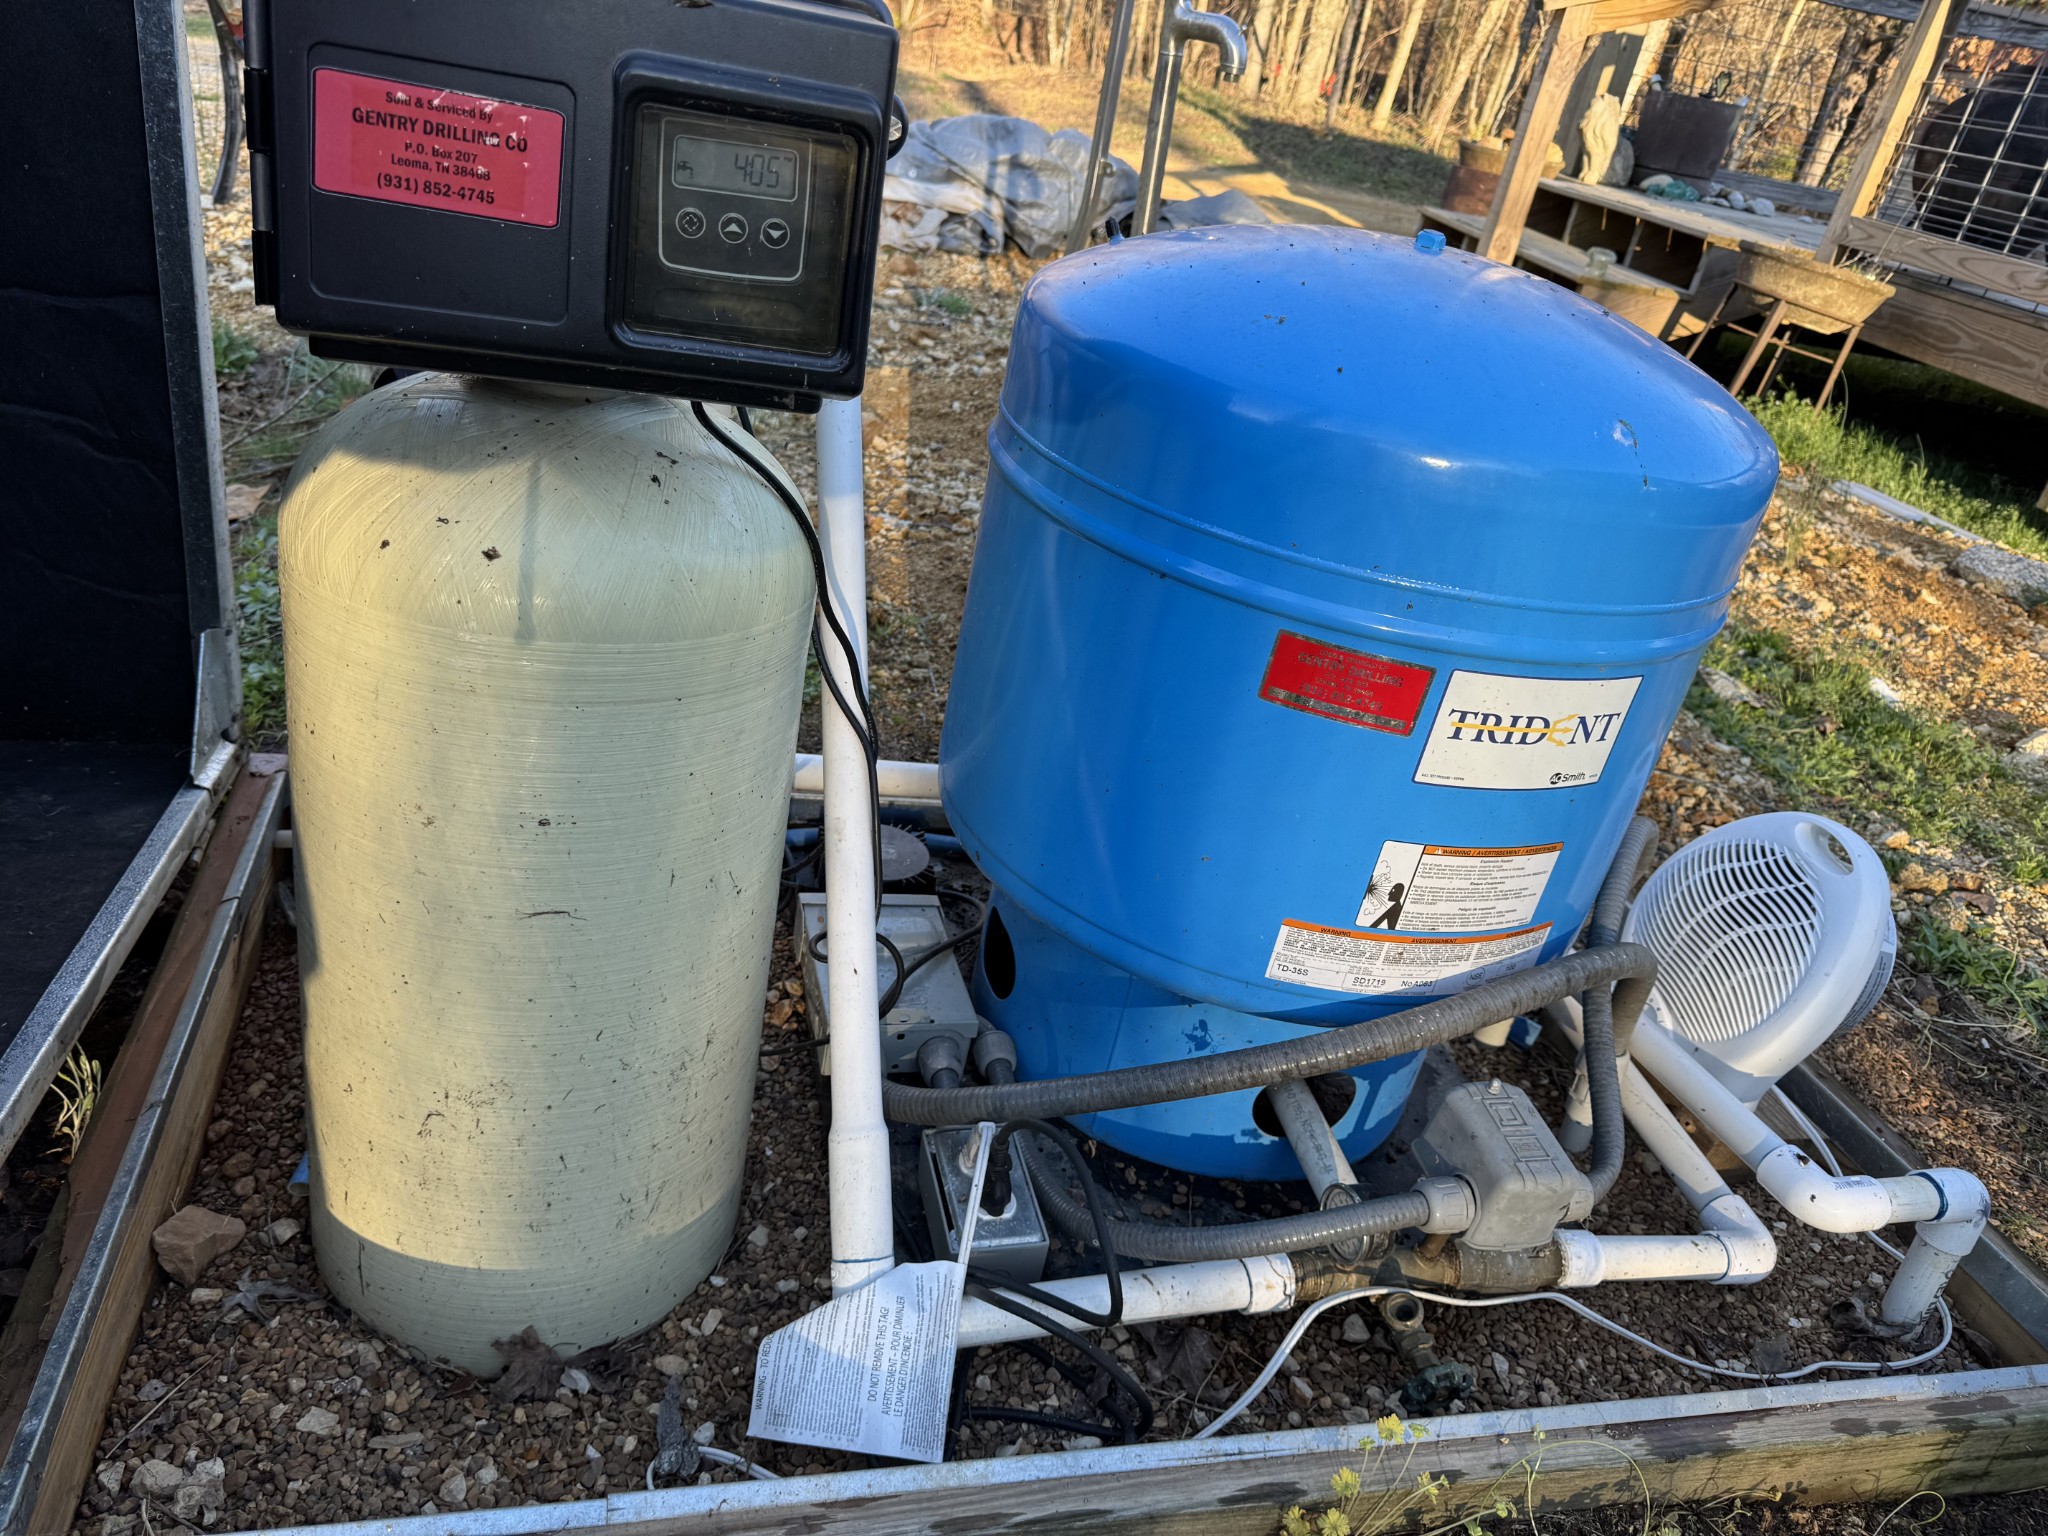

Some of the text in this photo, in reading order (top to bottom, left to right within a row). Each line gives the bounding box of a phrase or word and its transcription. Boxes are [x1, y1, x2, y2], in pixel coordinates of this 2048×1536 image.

[386, 91, 493, 124] Sold & Serviced By
[352, 107, 528, 152] GENTRY DRILLING CO
[391, 153, 432, 172] Leoma,
[435, 161, 450, 175] TN
[405, 141, 478, 164] P.O. Box 207
[377, 172, 495, 205] (931) 852-4745
[1297, 652, 1345, 672] GENTRY
[1348, 665, 1404, 688] DRILLING
[1446, 708, 1622, 747] TRIDENT
[1561, 771, 1586, 783] Smith
[1319, 927, 1352, 937] WARNING
[1276, 963, 1309, 977] TD-35S
[1352, 976, 1387, 986] SD1719
[892, 1295, 906, 1330] DIMINUER
[867, 1306, 890, 1402] DO NOT REMOVE THIS TAG!
[890, 1330, 901, 1351] POUR
[898, 1334, 913, 1376] D'INCENDIE
[759, 1354, 769, 1369] TO
[754, 1375, 767, 1410] WARNING
[881, 1357, 898, 1416] AVERTISSEMENT
[895, 1376, 907, 1408] DANGER
[893, 1407, 903, 1417] LE
